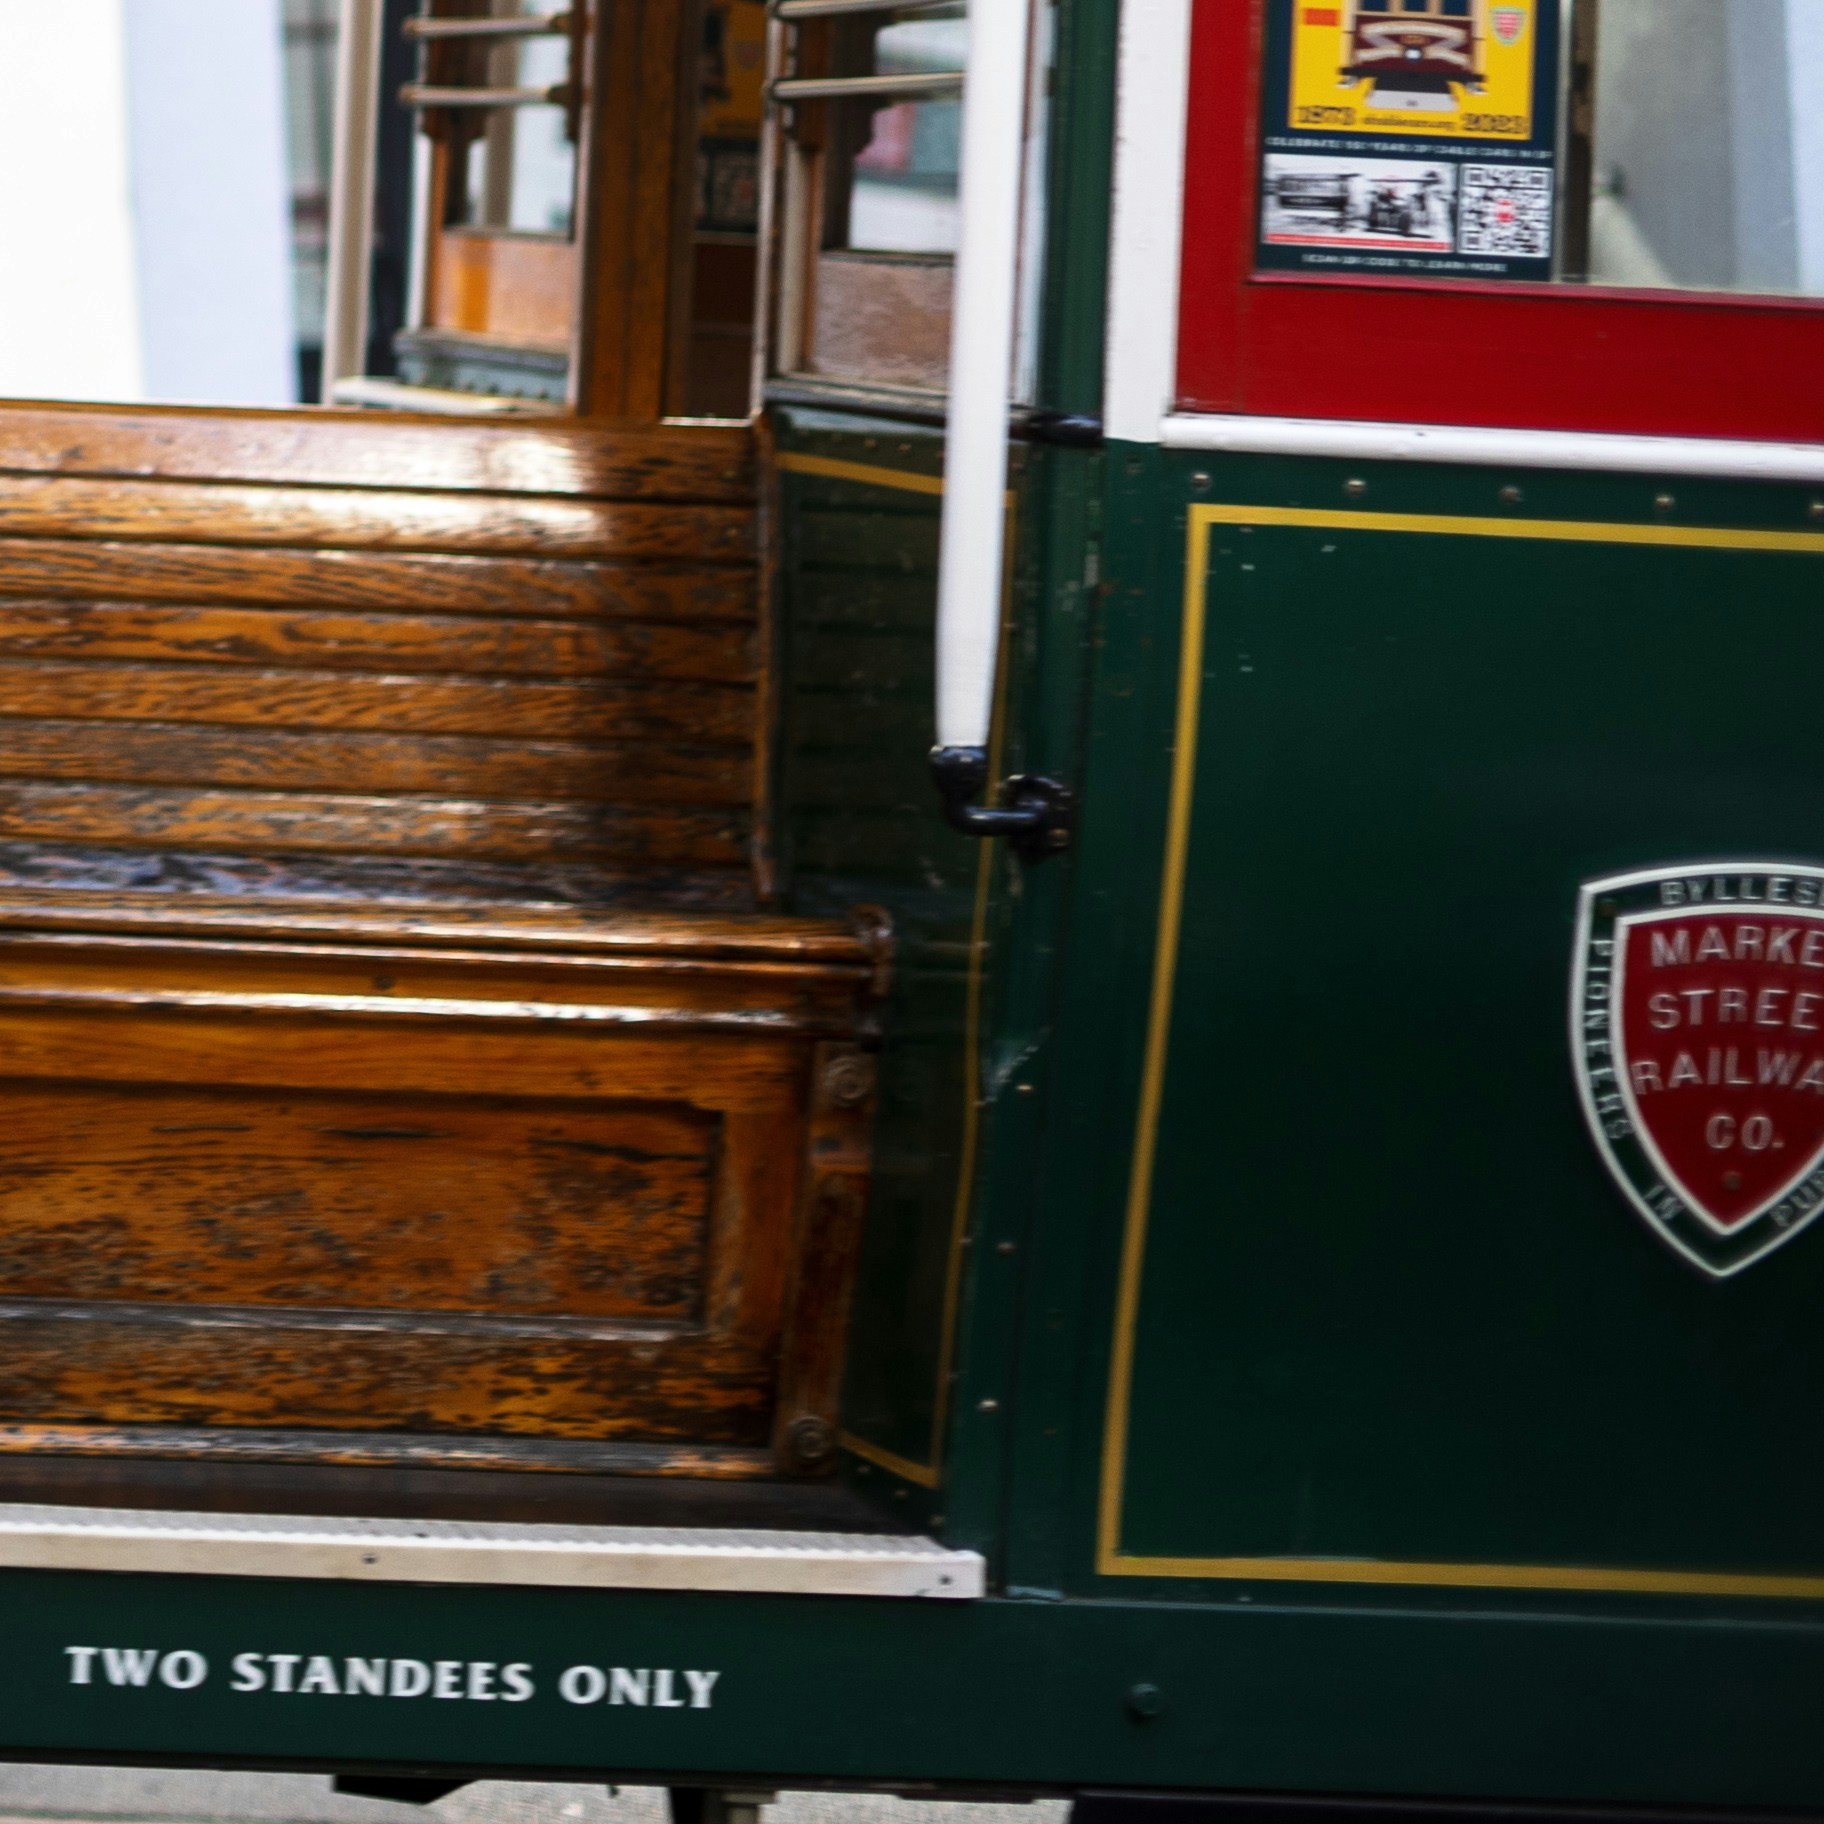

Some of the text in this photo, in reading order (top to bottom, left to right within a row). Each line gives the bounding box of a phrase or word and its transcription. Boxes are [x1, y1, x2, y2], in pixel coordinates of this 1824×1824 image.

[1660, 877, 1824, 906] BYLLES
[1651, 925, 1824, 968] MARKE
[1647, 988, 1824, 1030] STREE
[1630, 1047, 1824, 1095] RAILWA
[1705, 1115, 1785, 1151] CO.
[64, 1644, 721, 1710] TWO STANDEES ONLY
